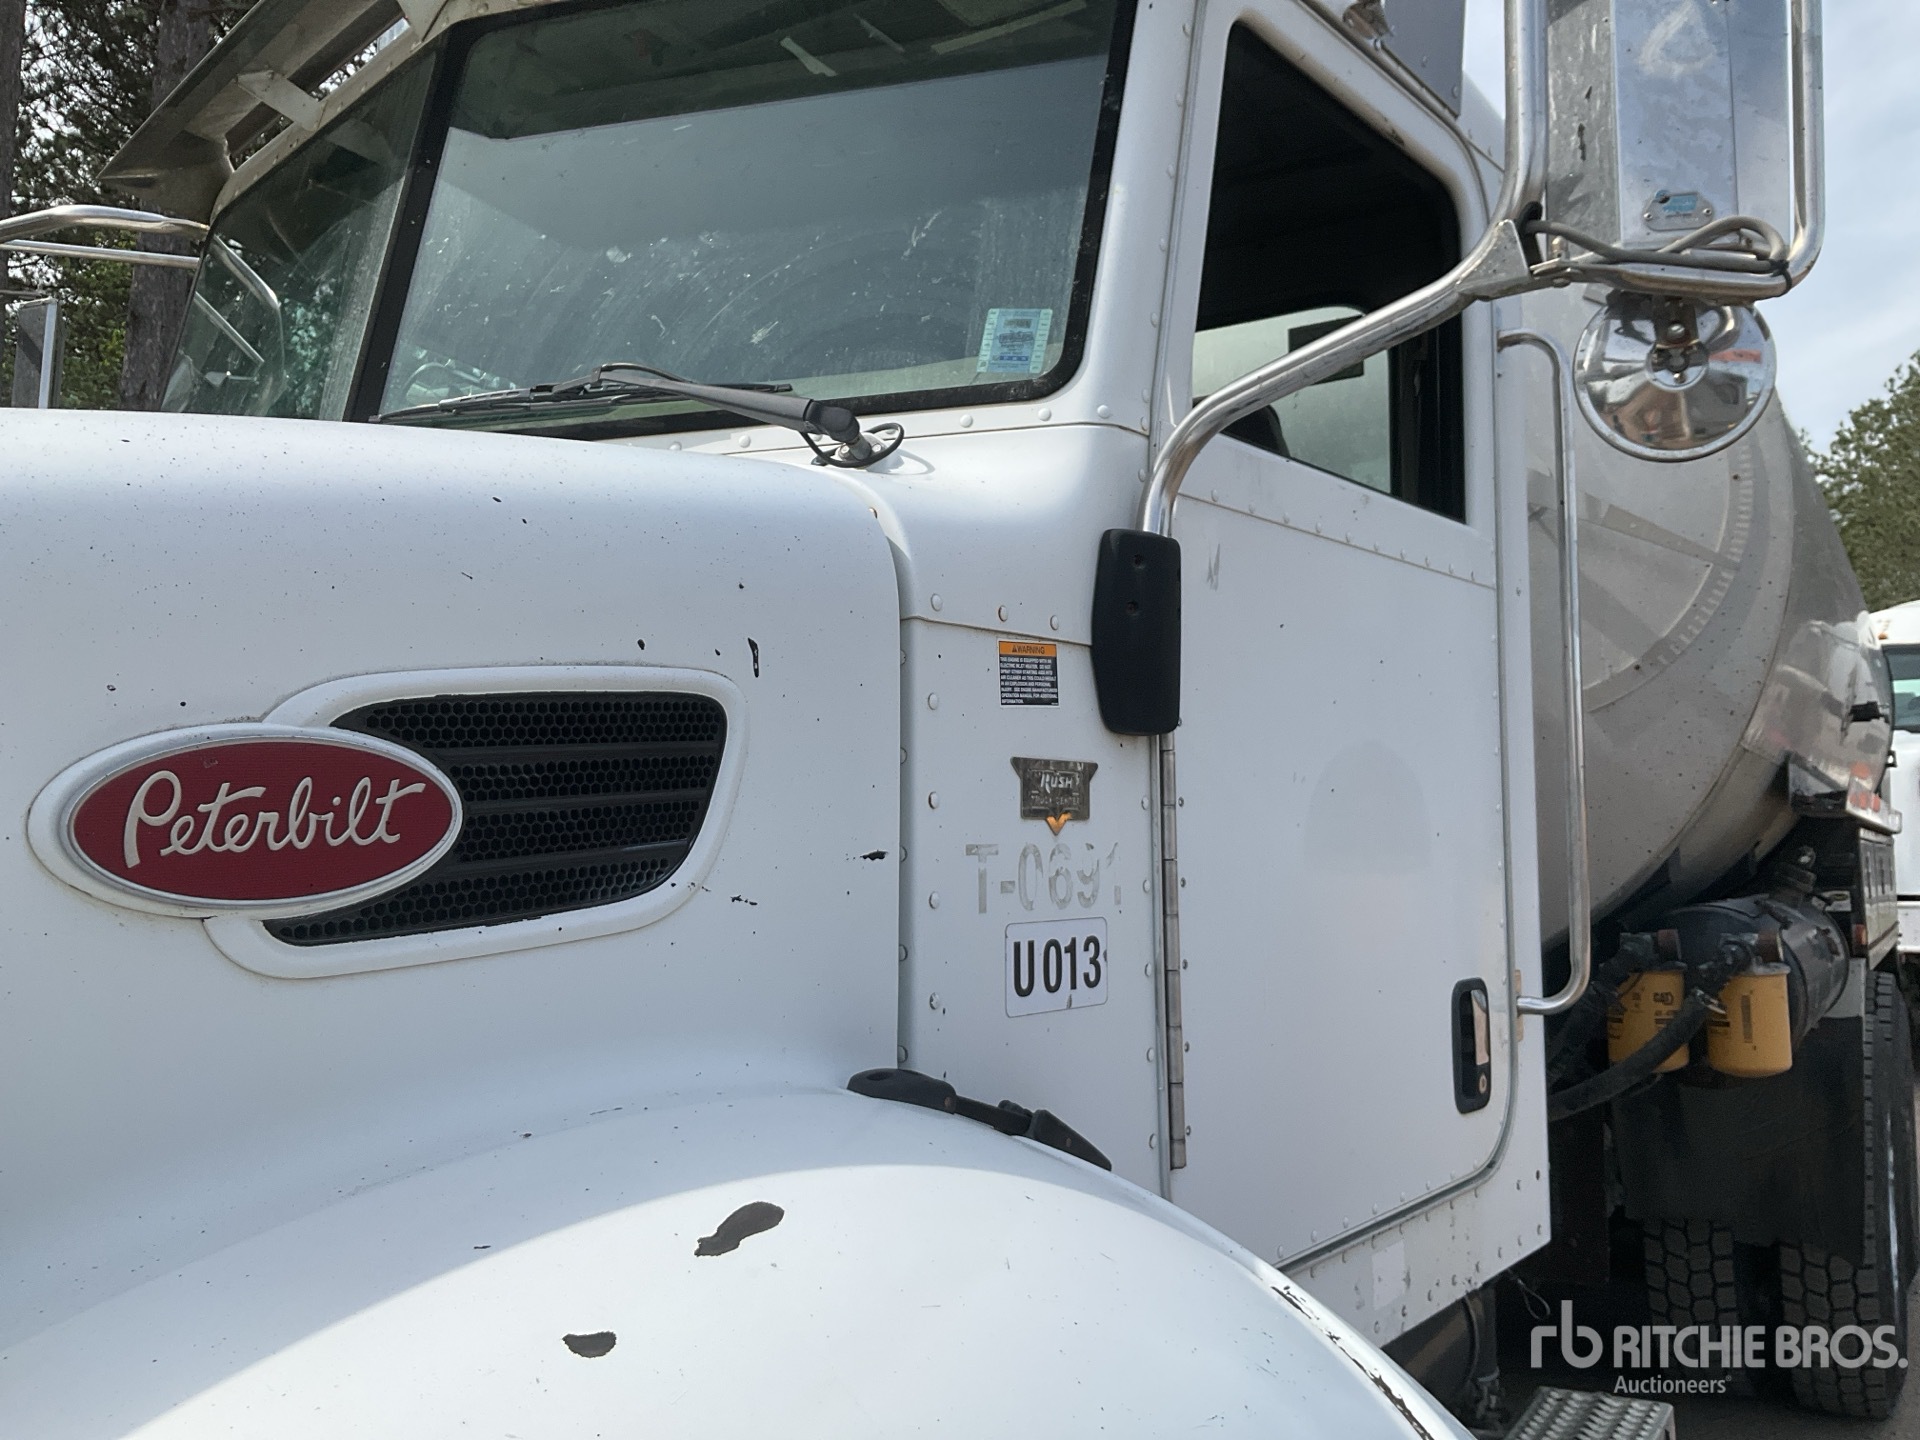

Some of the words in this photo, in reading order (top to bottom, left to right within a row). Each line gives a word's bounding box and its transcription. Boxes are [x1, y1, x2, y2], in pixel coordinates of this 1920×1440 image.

[1016, 645, 1045, 655] WARNING
[1040, 773, 1073, 794] RUSH
[123, 770, 427, 869] Peterbilt
